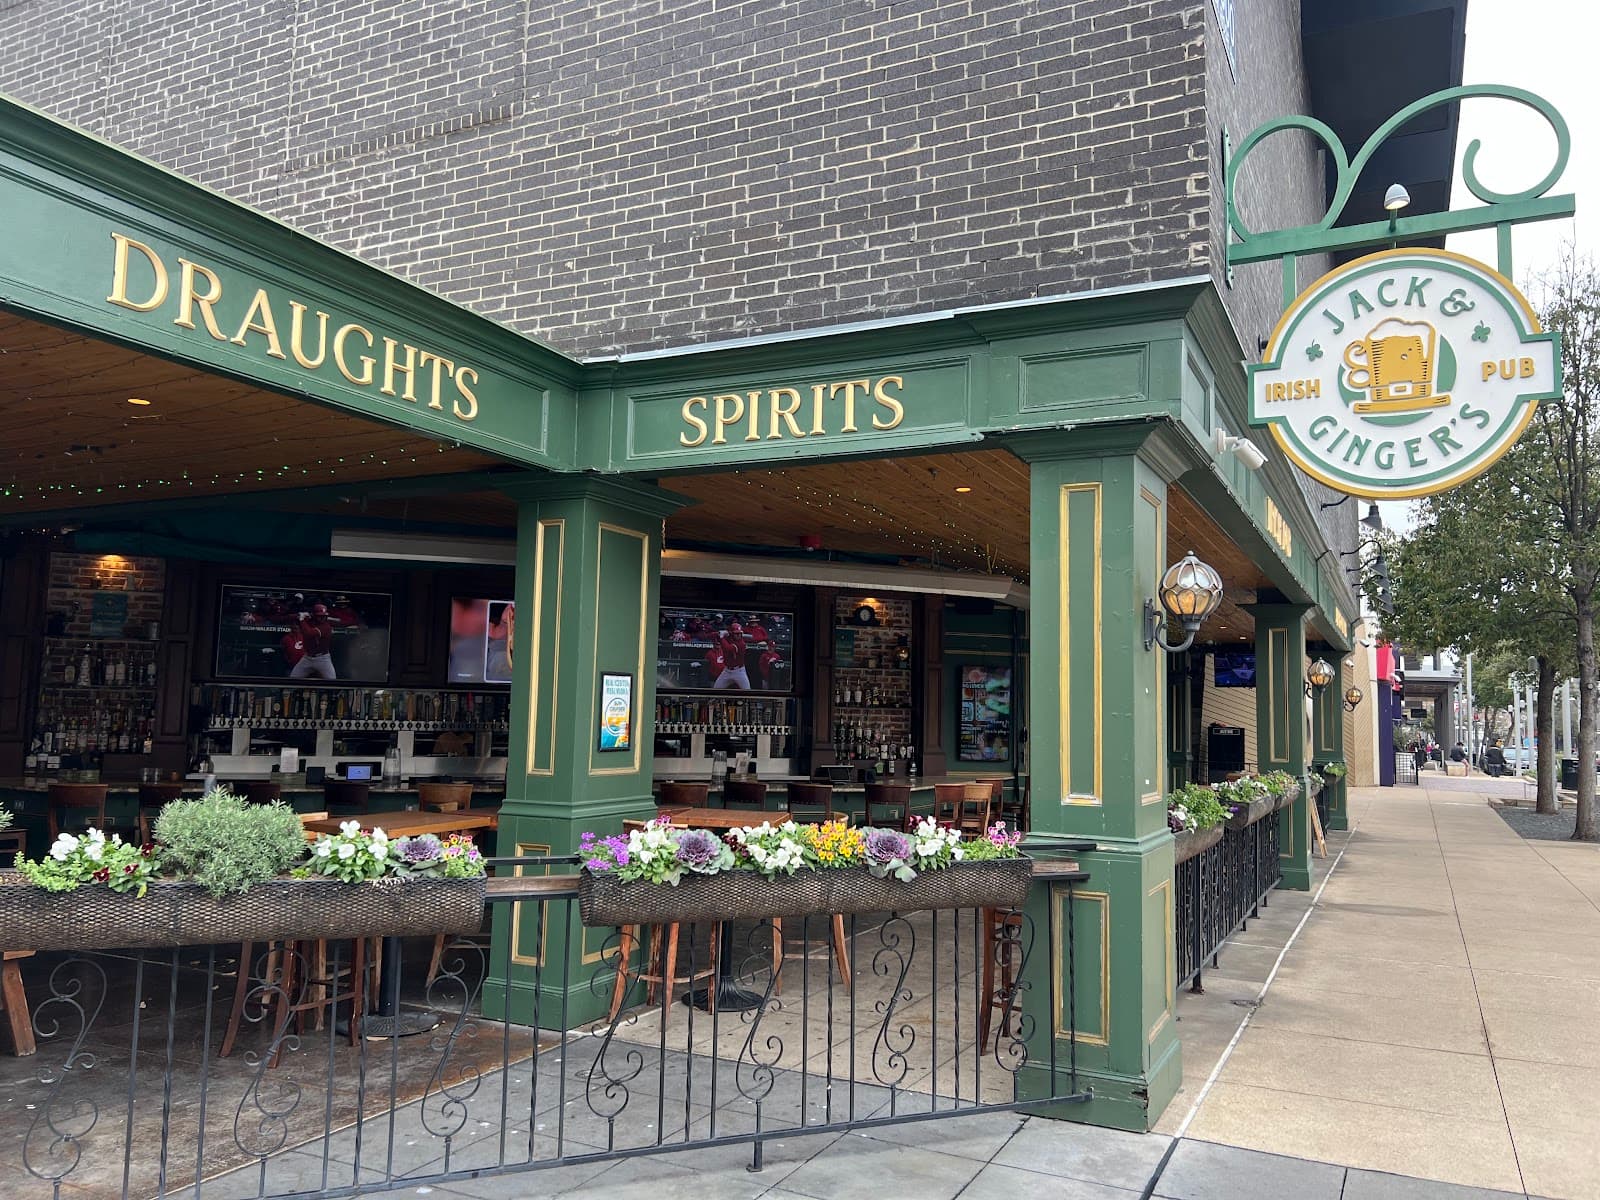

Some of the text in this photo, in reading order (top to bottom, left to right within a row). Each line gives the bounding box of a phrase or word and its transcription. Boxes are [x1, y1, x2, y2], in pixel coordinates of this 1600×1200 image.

[106, 231, 480, 422] DRAUGHTS
[1322, 276, 1476, 335] JACK &
[1264, 379, 1321, 402] IRISH
[1481, 357, 1535, 381] PUB
[679, 375, 905, 447] SPIRITS
[1309, 403, 1491, 470] GINGER'S
